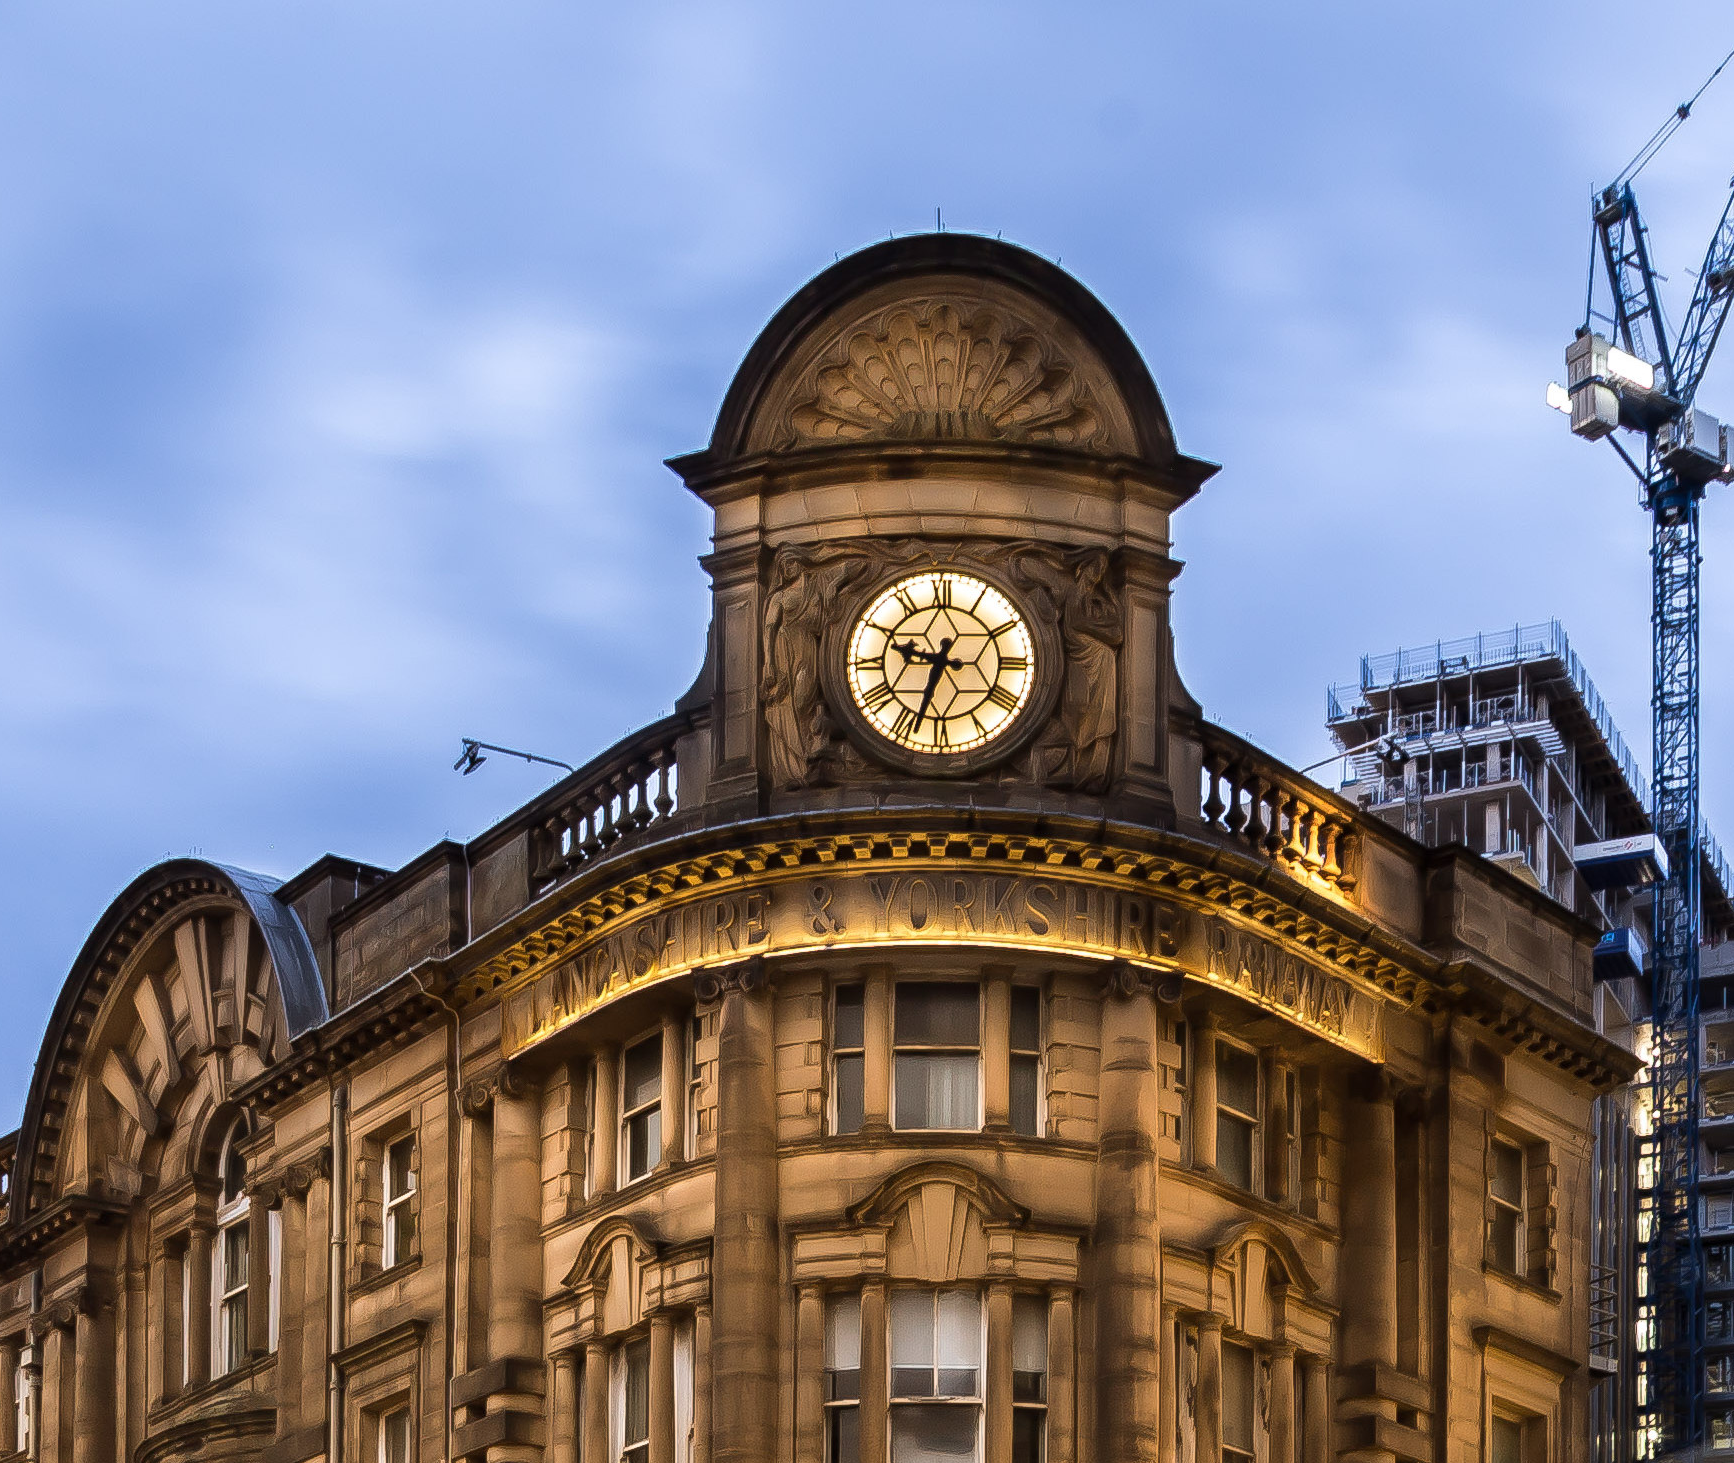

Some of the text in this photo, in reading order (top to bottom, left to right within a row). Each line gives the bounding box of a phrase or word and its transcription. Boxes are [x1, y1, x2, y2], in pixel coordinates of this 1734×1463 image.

[532, 877, 1358, 1038] LANCASHIRE & YORKSHIRE RAILWAY
